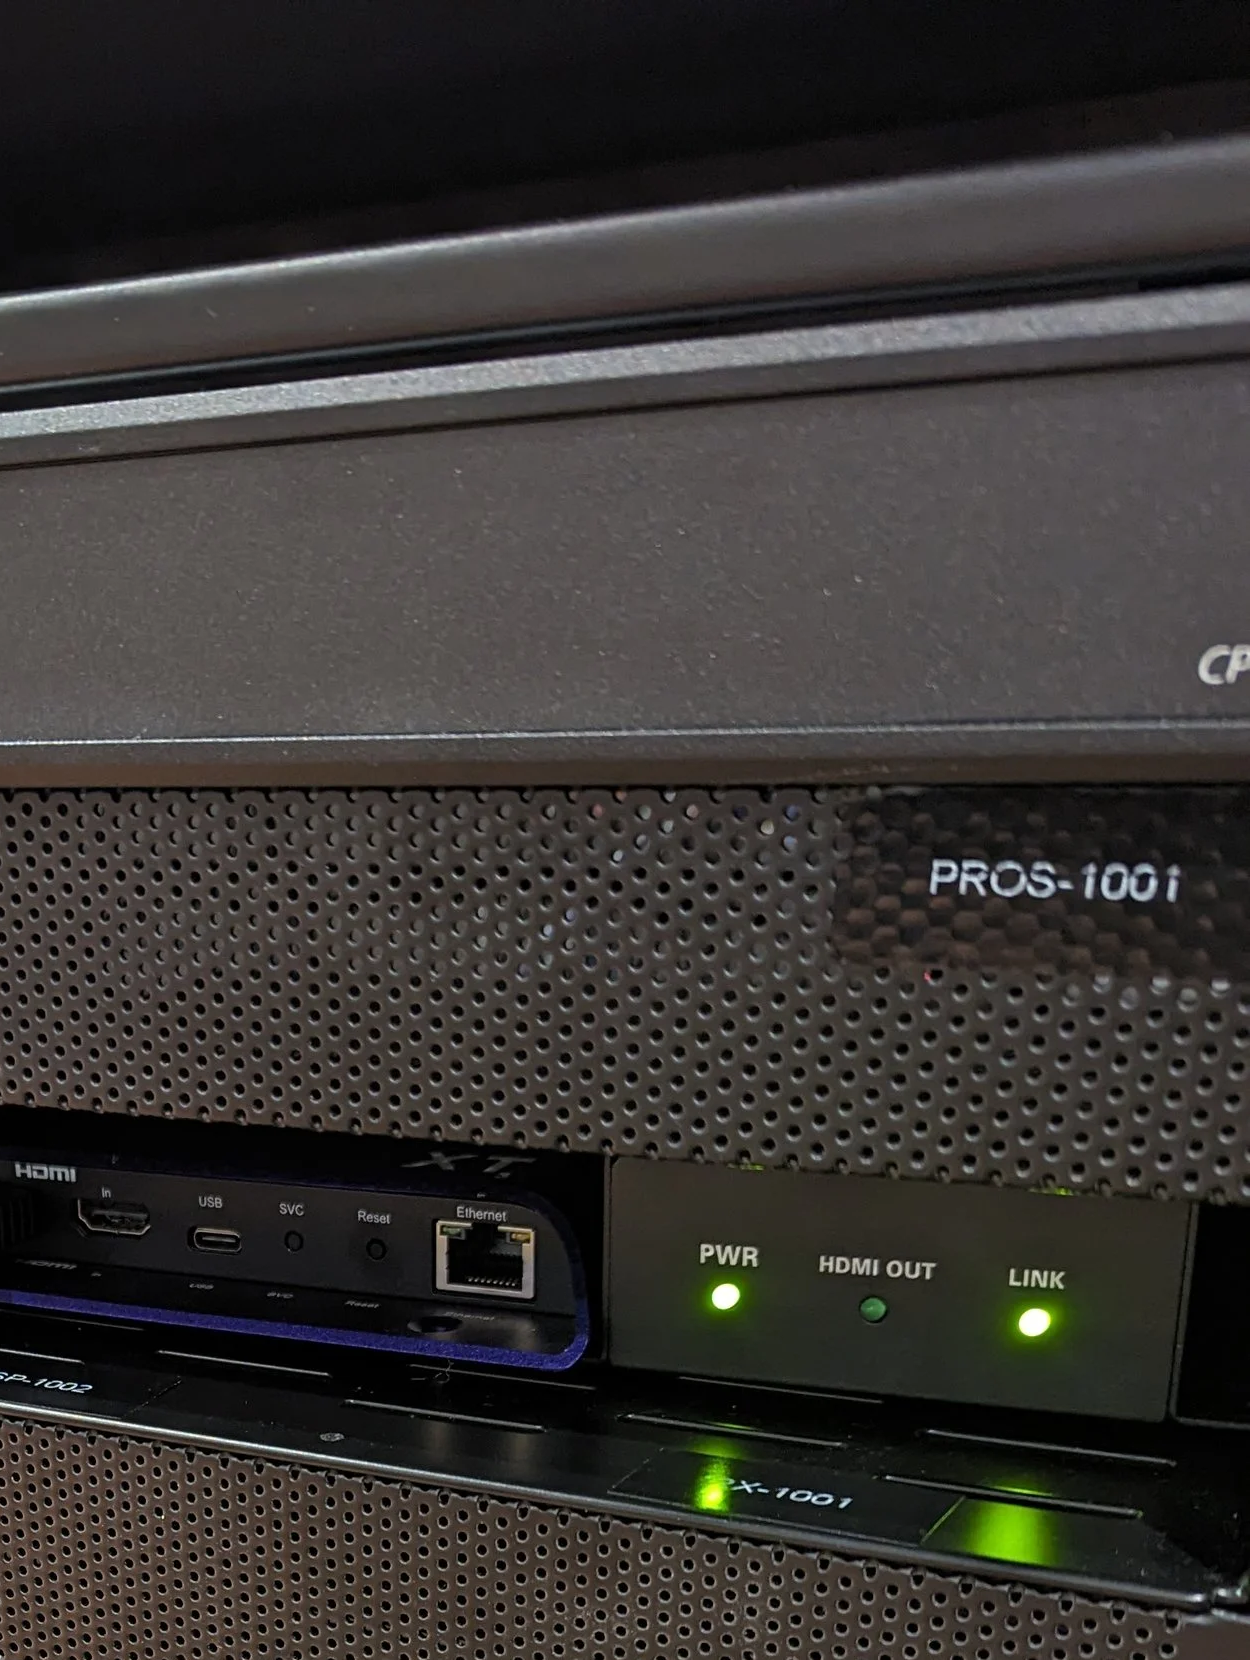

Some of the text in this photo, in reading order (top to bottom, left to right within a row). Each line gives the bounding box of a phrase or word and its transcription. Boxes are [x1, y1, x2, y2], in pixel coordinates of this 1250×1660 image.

[929, 859, 1181, 902] PROS-1001
[14, 1162, 77, 1183] HDMI
[101, 1187, 111, 1198] In
[198, 1196, 507, 1225] USB SVC Reset Ethernet
[699, 1243, 759, 1268] PWR
[818, 1254, 936, 1281] HDMI OUT
[1008, 1267, 1065, 1290] LINK
